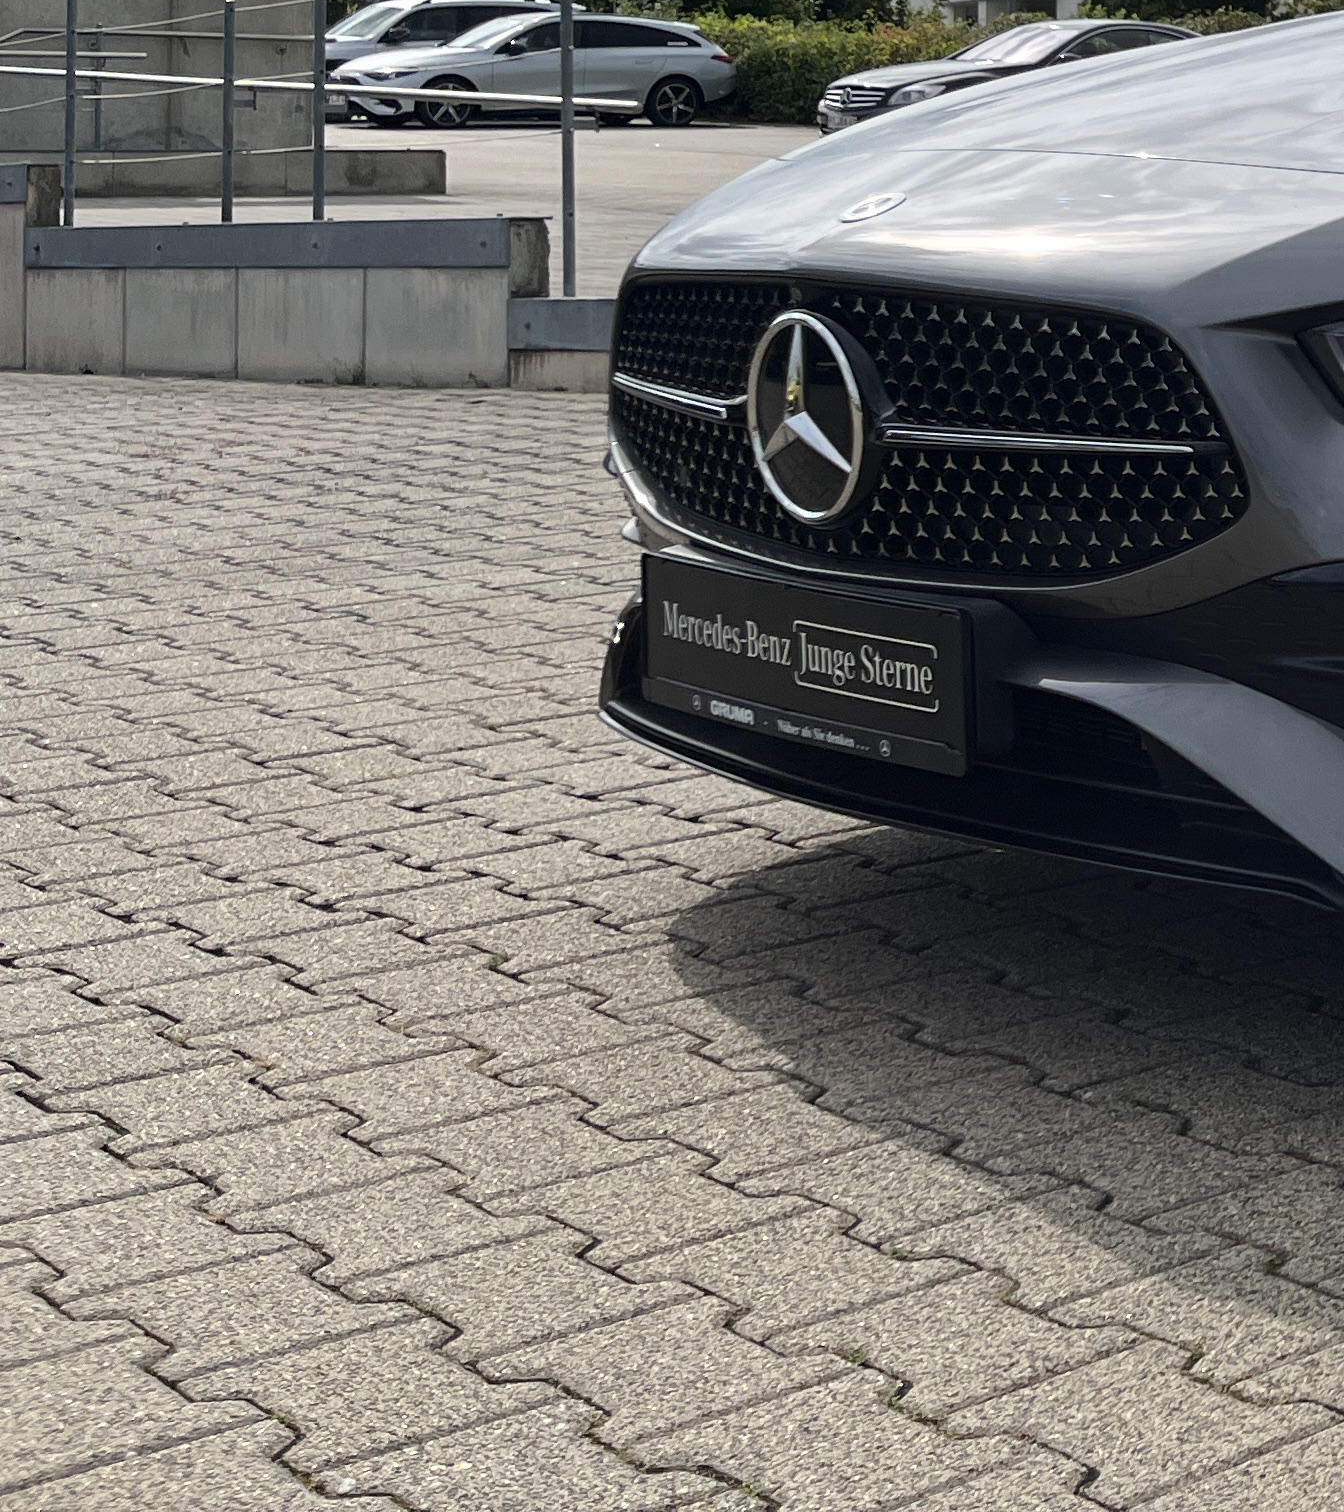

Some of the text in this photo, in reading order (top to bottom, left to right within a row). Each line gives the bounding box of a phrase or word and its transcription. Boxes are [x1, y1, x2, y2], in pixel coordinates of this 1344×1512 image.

[662, 600, 934, 695] Mercedes-Benz Junge Sterne
